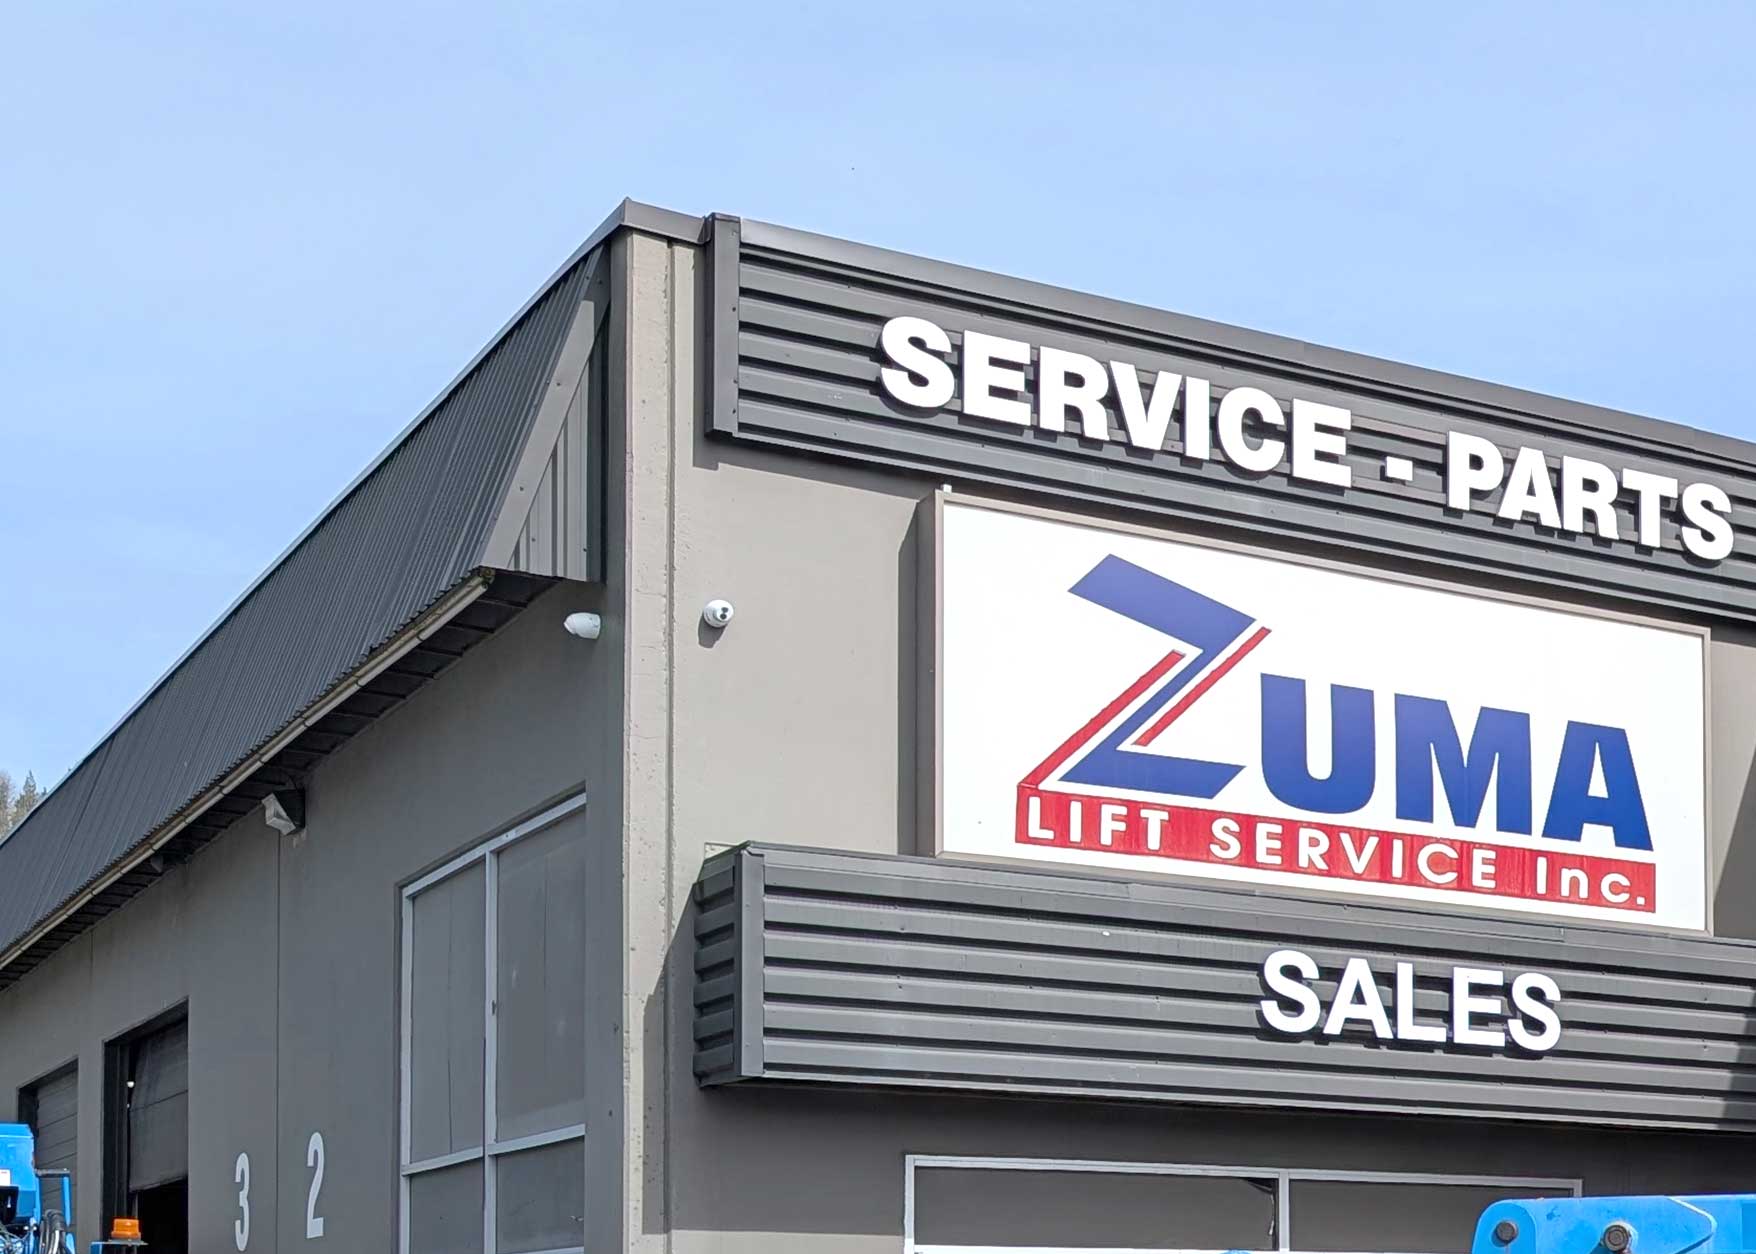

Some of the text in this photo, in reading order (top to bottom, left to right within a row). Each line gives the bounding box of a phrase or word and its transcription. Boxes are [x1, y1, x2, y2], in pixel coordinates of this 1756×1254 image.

[880, 316, 1352, 488] SERVICE
[1447, 430, 1734, 560] PARTS
[1068, 554, 1654, 852] ZUMA
[1028, 796, 1645, 905] LIFT SERVICE Inc.
[1261, 949, 1561, 1051] SALES
[235, 1152, 250, 1251] 3
[306, 1132, 324, 1239] 2
